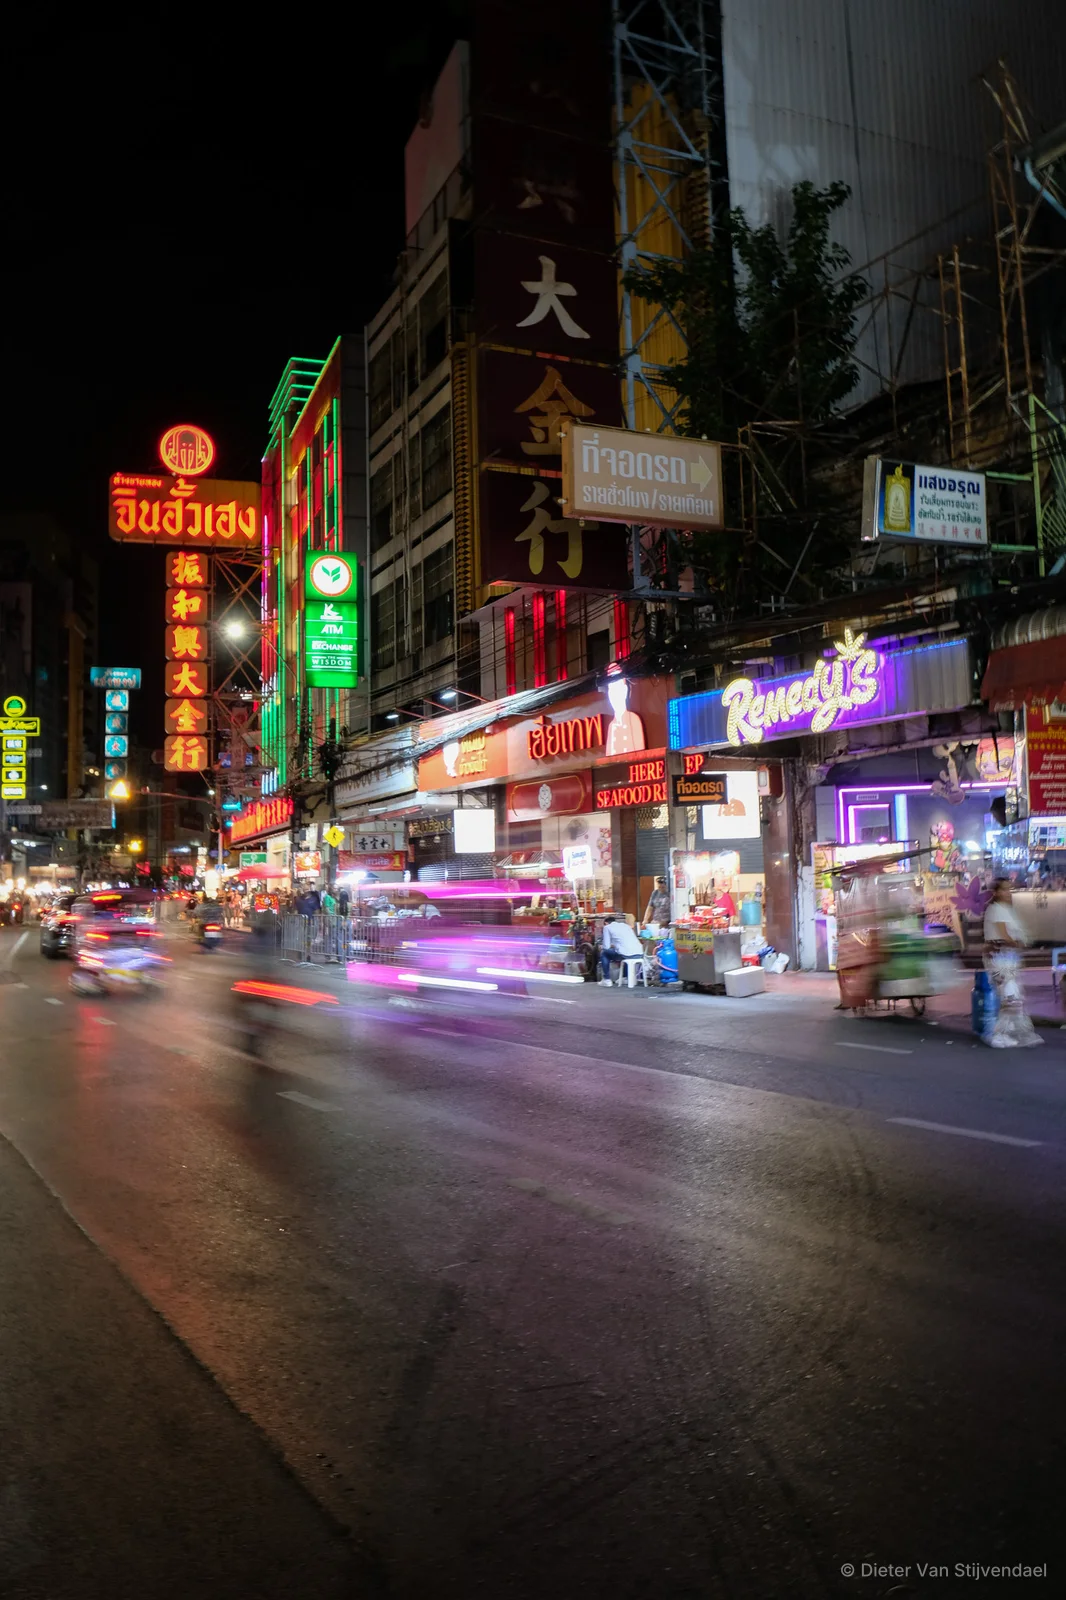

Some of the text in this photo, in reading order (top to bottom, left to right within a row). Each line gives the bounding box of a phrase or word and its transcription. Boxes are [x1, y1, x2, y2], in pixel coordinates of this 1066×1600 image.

[582, 432, 687, 485] ที่จอดรถ
[582, 481, 714, 517] รายชั่วโมง/รายเดือน
[918, 474, 981, 499] แสงอรุณ
[320, 624, 343, 634] ATM
[170, 551, 204, 770] 振和興大金行
[527, 713, 604, 760] เฮียเทพ
[629, 760, 665, 783] HERE
[596, 783, 652, 809] SEAFOOD
[676, 776, 725, 795] ที่จอดรถ
